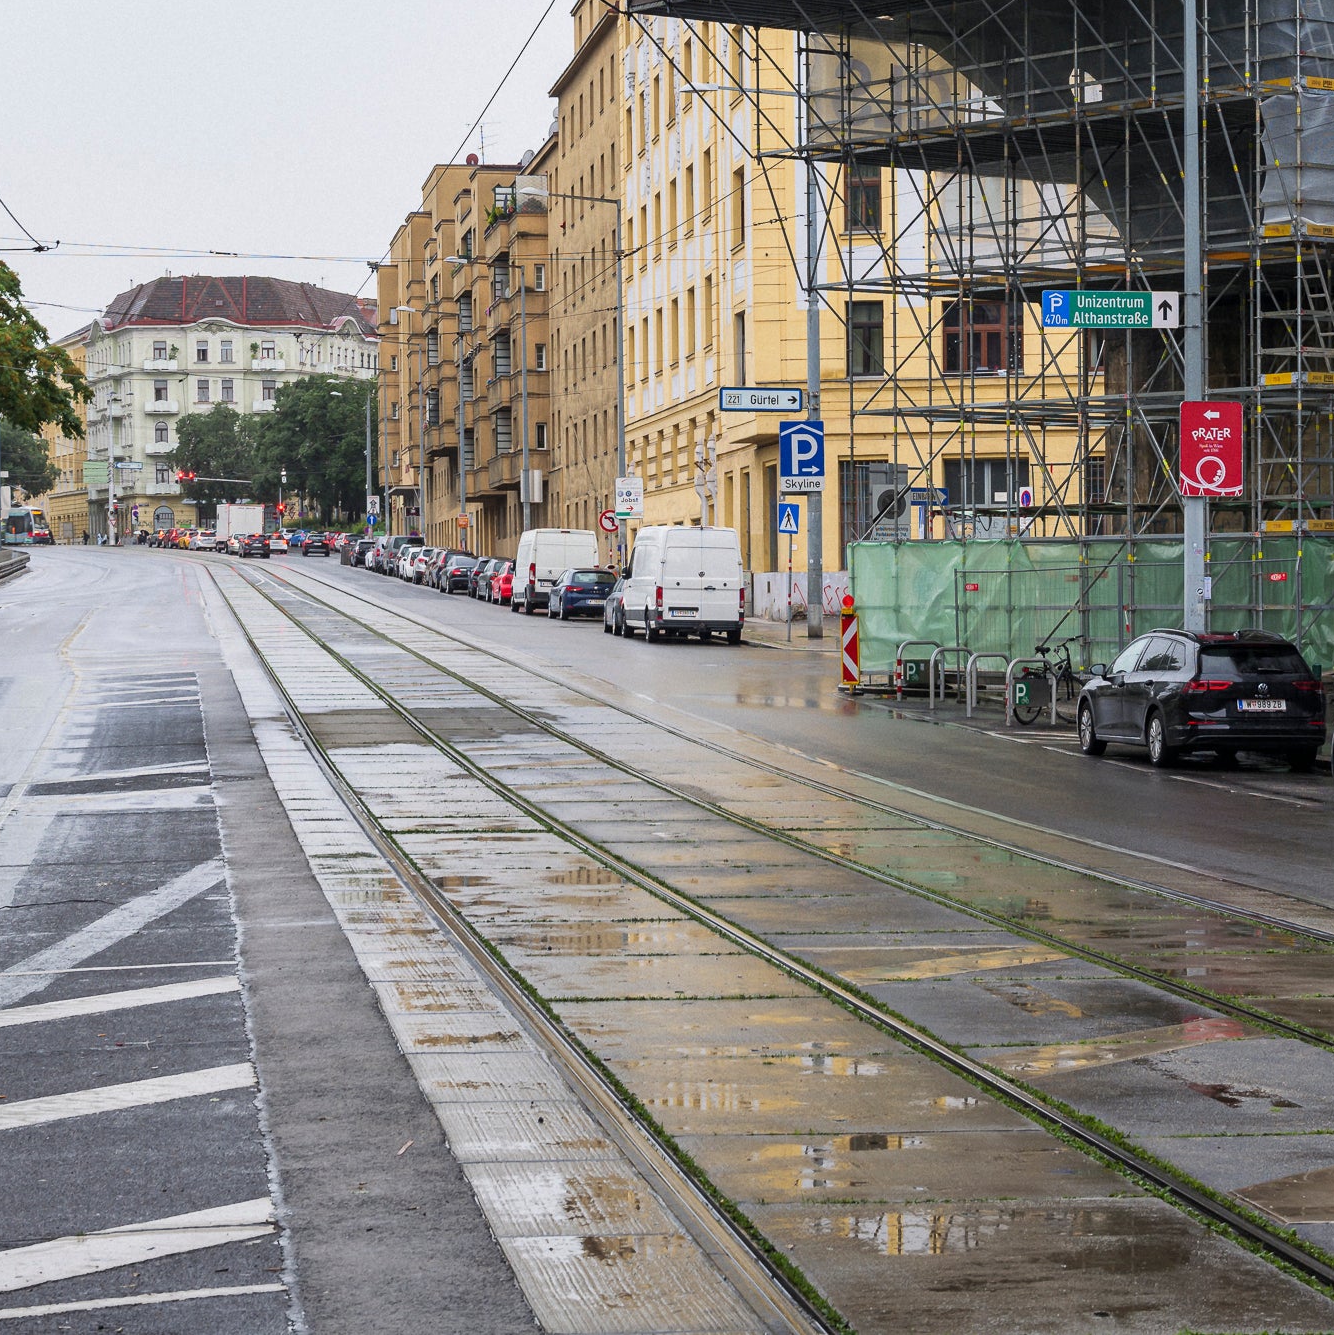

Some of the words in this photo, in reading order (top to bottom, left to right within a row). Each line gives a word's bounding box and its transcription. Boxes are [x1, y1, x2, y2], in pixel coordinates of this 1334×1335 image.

[1050, 297, 1063, 313] P
[1077, 295, 1144, 309] Unizentrum
[1044, 314, 1068, 325] 470m
[1073, 311, 1149, 326] Althanstraße
[727, 395, 740, 404] 221
[750, 394, 779, 405] Gürtel
[1191, 427, 1231, 441] PRATER
[791, 433, 818, 475] P
[785, 478, 821, 490] Skyline
[906, 662, 916, 680] P
[1015, 684, 1026, 703] P
[1246, 699, 1252, 708] W
[1257, 699, 1271, 708] 989
